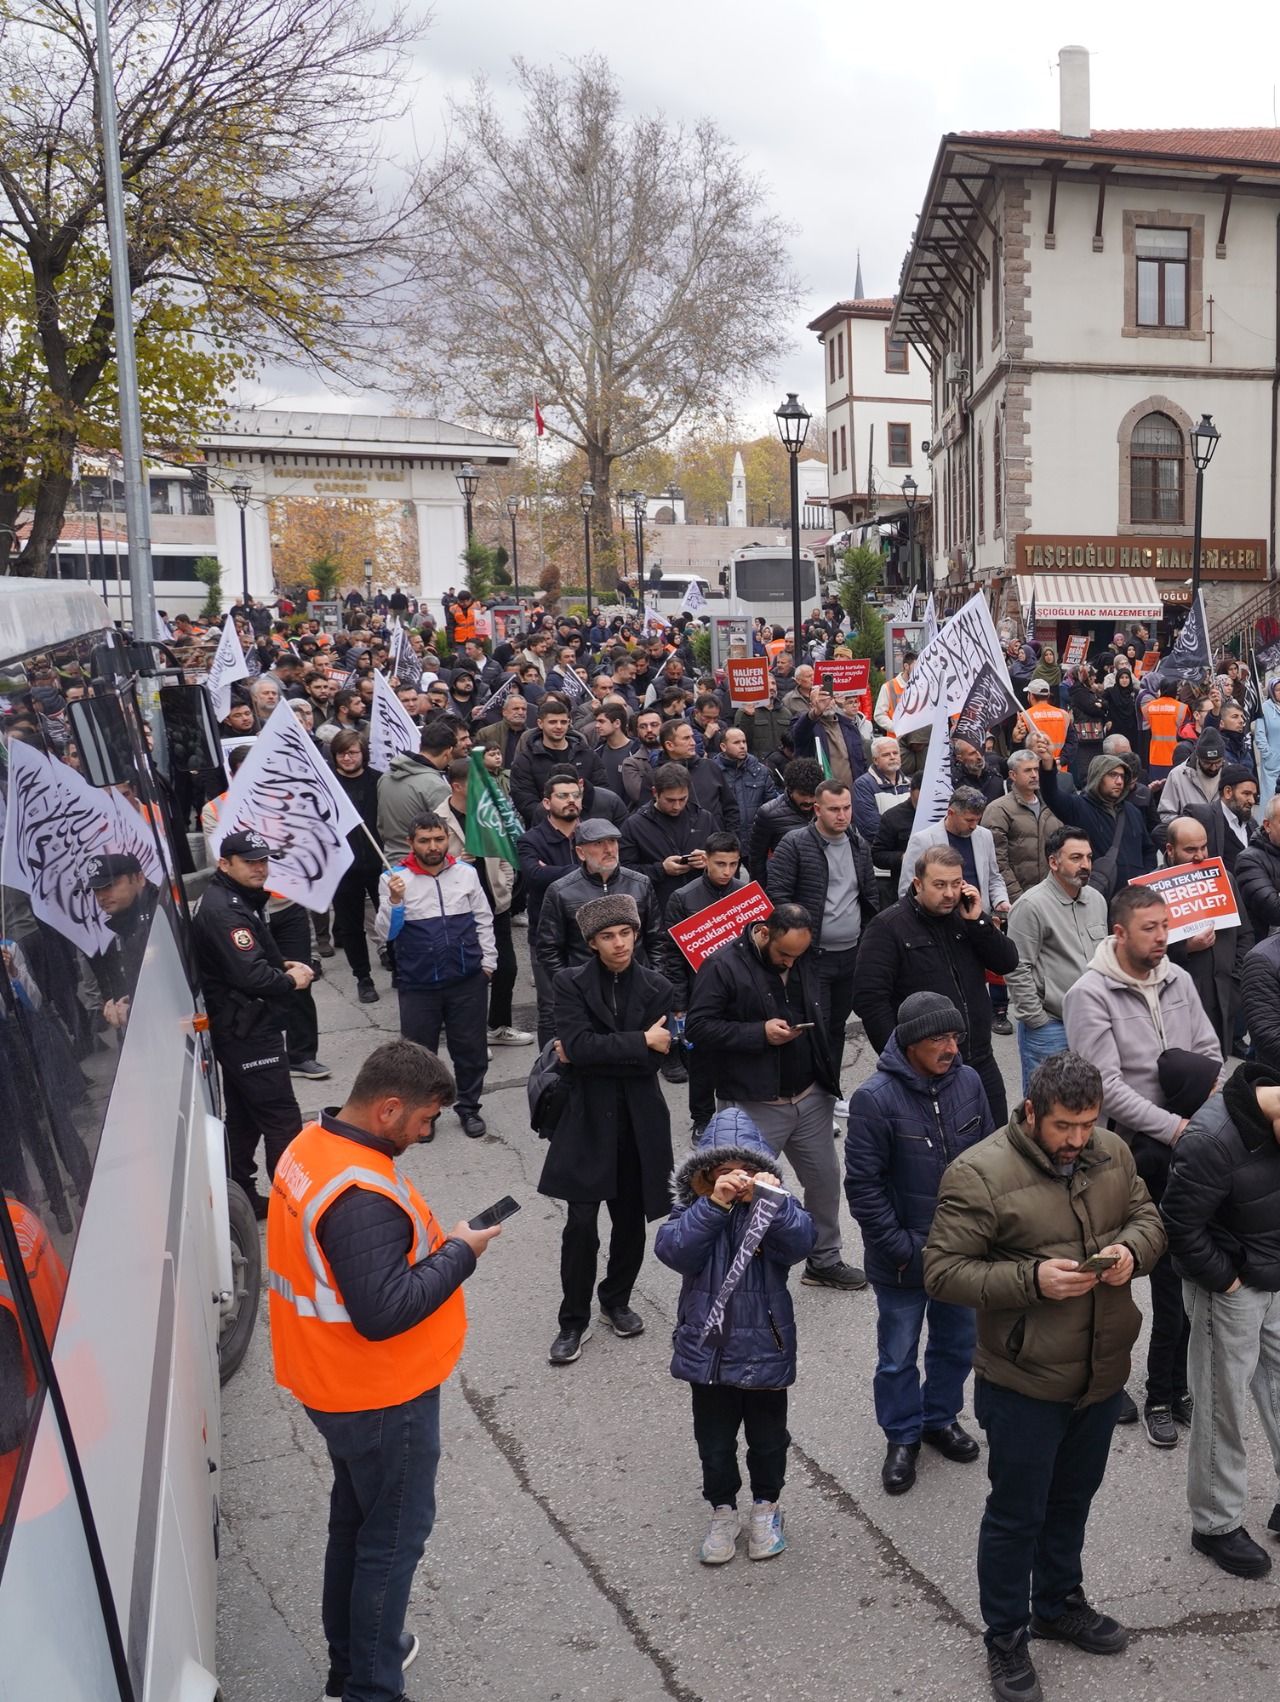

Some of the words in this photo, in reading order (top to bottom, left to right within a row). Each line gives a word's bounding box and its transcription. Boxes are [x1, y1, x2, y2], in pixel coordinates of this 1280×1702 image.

[313, 482, 368, 495] ÇARŞISI
[1025, 542, 1116, 569] TAŞÇIOĞLU
[1120, 547, 1151, 568] HAC
[1078, 608, 1096, 616] HAC
[1099, 607, 1162, 617] MALZEMELERİ
[733, 667, 764, 677] HALİFEN
[734, 676, 765, 687] YOKSA
[1172, 875, 1191, 886] TEK
[1190, 868, 1220, 882] MİLLET
[1170, 894, 1227, 919] DEVLET?
[686, 920, 736, 953] çocukların
[736, 901, 769, 924] ölmesi
[700, 931, 739, 960] normal
[258, 1056, 280, 1066] KUVVET
